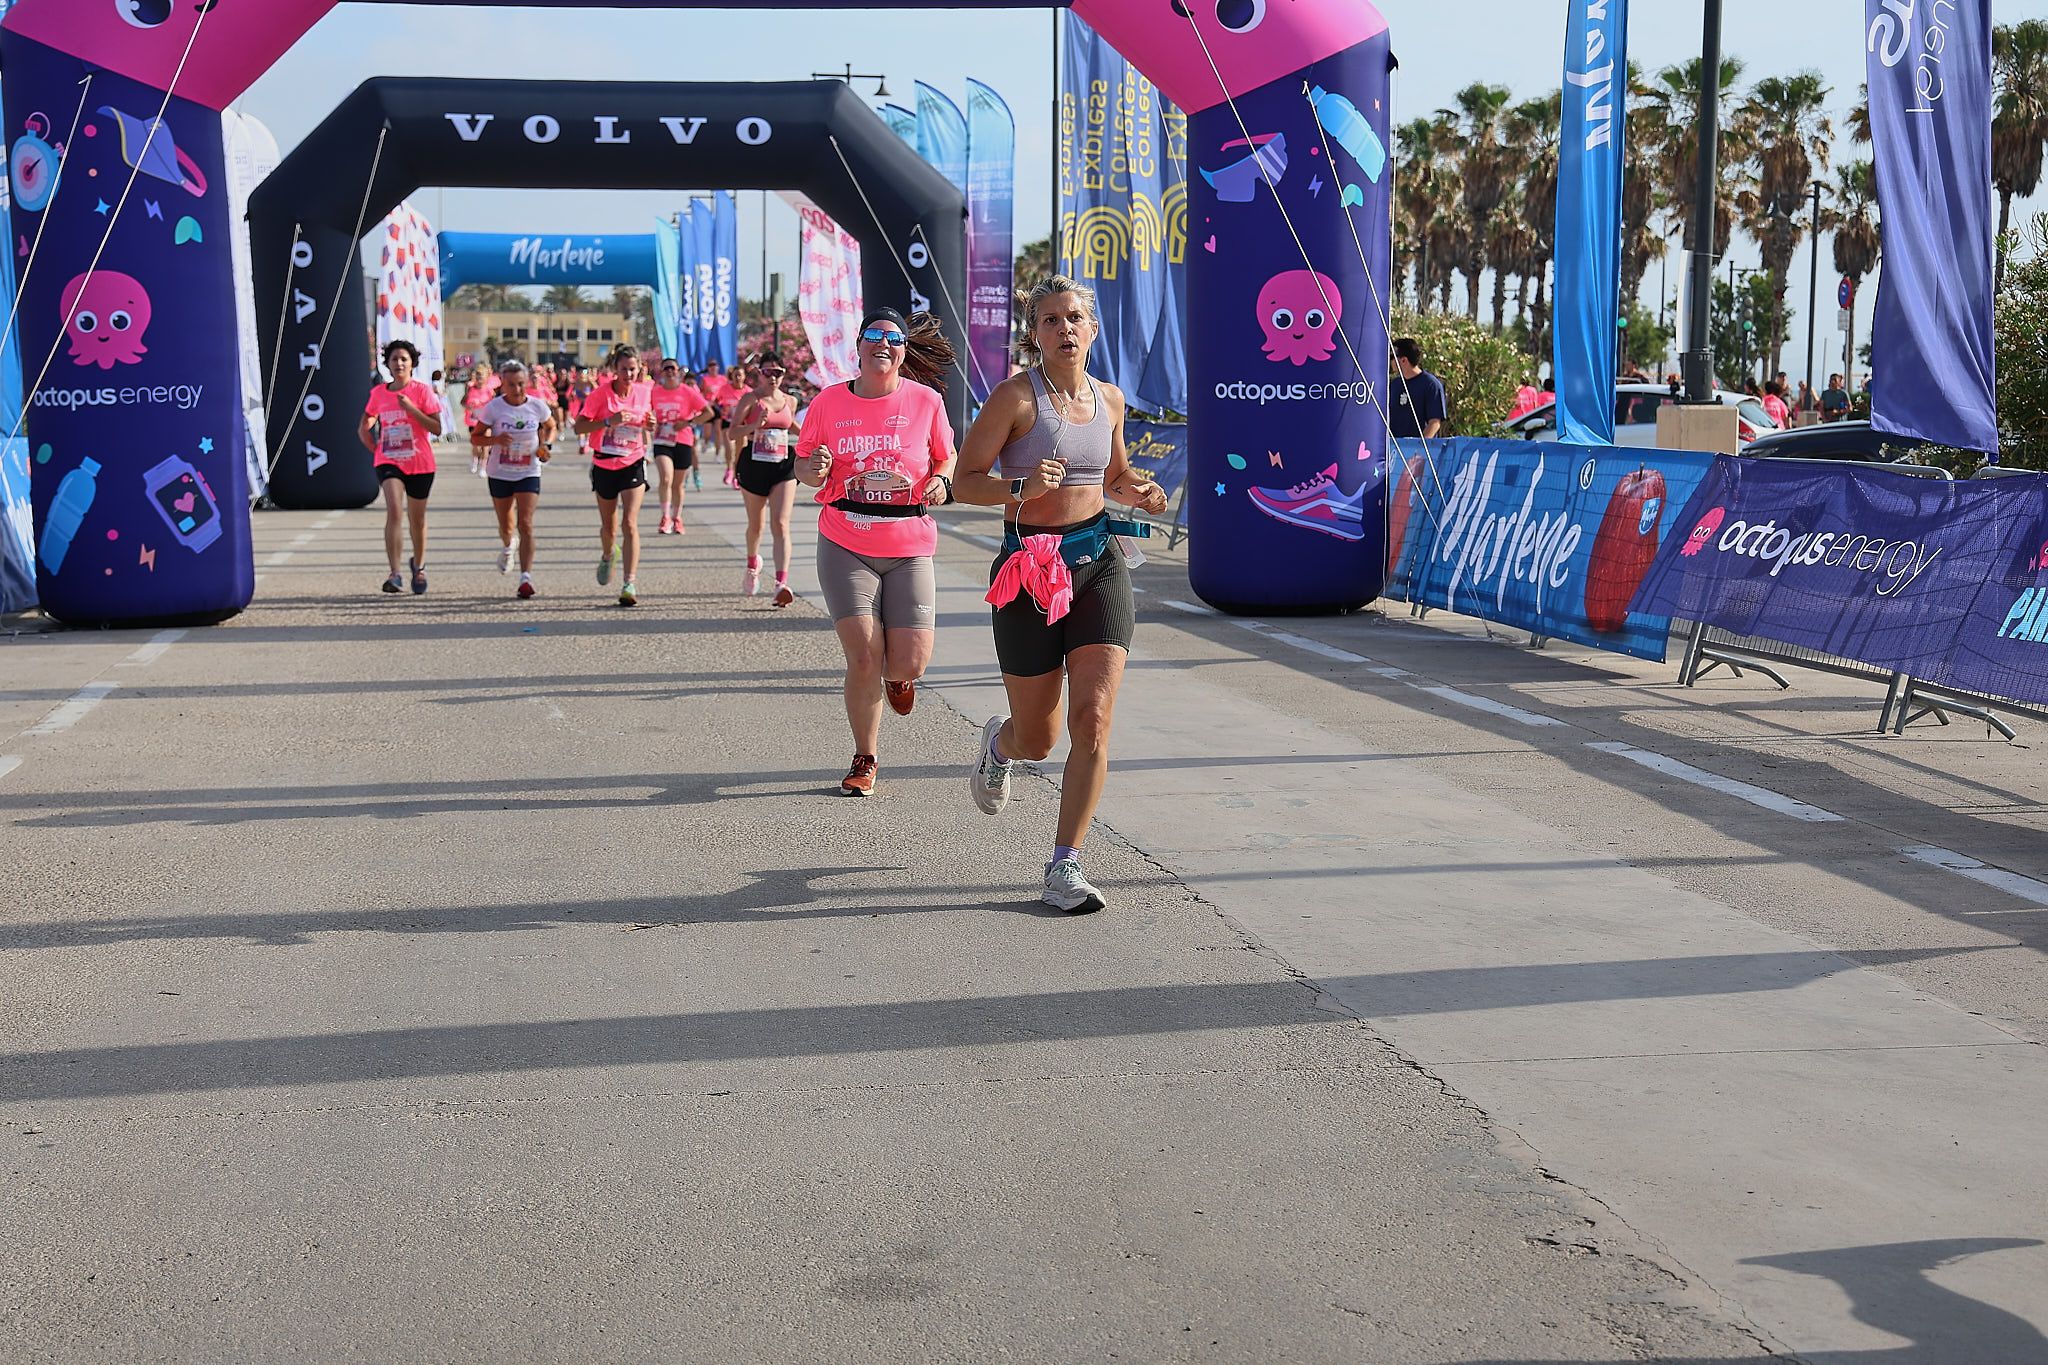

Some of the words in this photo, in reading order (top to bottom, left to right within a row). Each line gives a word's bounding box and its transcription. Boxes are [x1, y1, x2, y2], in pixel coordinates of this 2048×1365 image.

[444, 113, 773, 146] VOLVO
[509, 237, 604, 279] Marlene
[290, 240, 329, 476] VOLVO
[35, 387, 117, 412] octopus
[119, 384, 203, 410] energy
[1215, 381, 1306, 406] octopus
[1308, 381, 1375, 405] energy
[836, 419, 862, 429] OYSHO
[838, 434, 902, 455] CARRERA
[866, 490, 892, 501] 016
[1430, 448, 1582, 615] Marlene
[1718, 519, 1835, 577] octopus
[1824, 533, 1943, 598] energy
